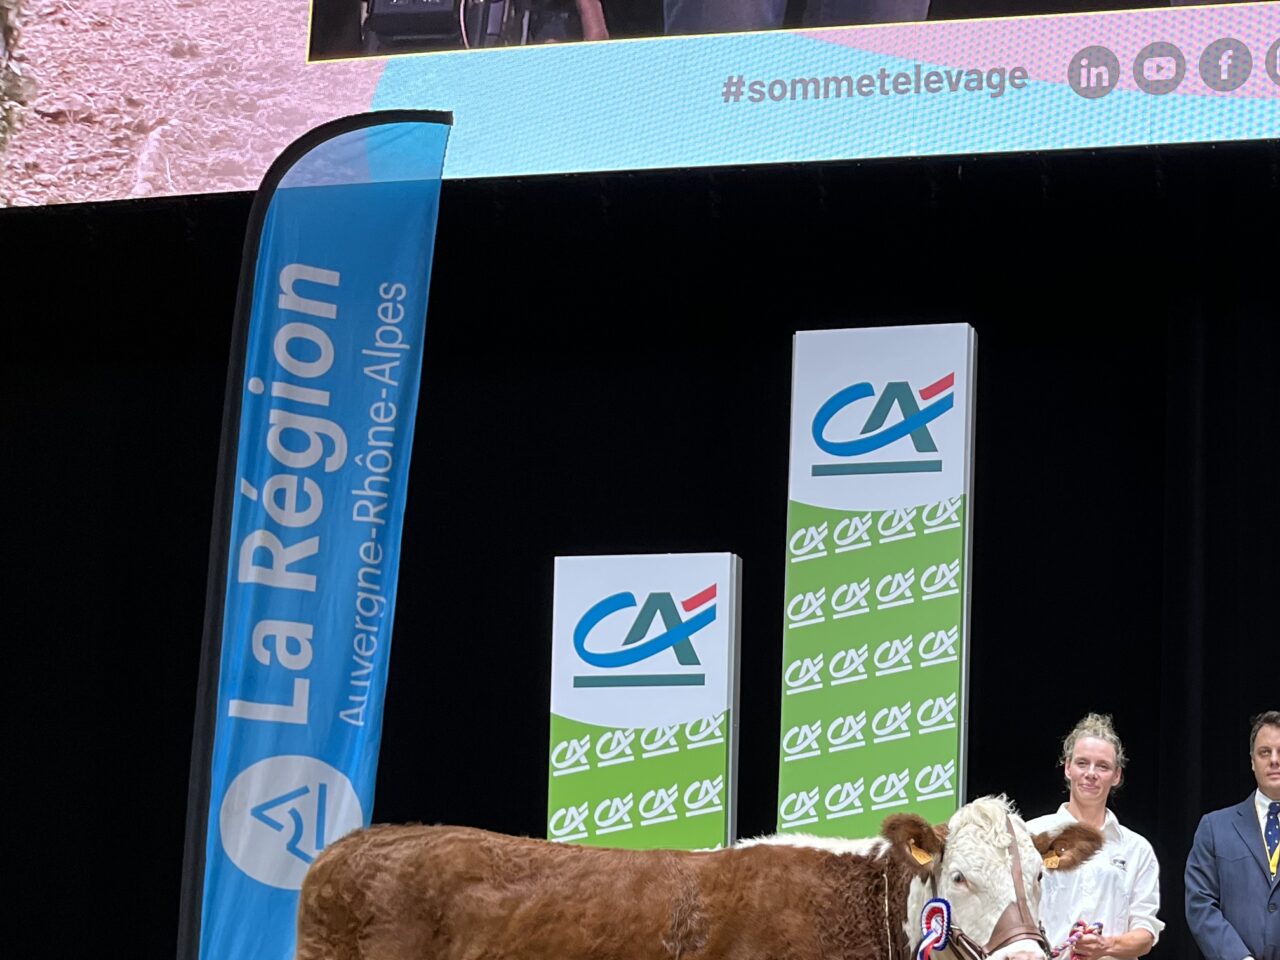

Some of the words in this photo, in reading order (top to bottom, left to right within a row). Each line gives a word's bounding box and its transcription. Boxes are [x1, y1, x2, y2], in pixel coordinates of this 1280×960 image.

[721, 64, 1029, 103] #sommetelevage
[237, 262, 349, 593] Région
[811, 371, 956, 458] CA
[339, 281, 411, 728] Auvergne-Rhône-Alpes
[227, 618, 314, 725] La
[573, 582, 718, 669] CA
